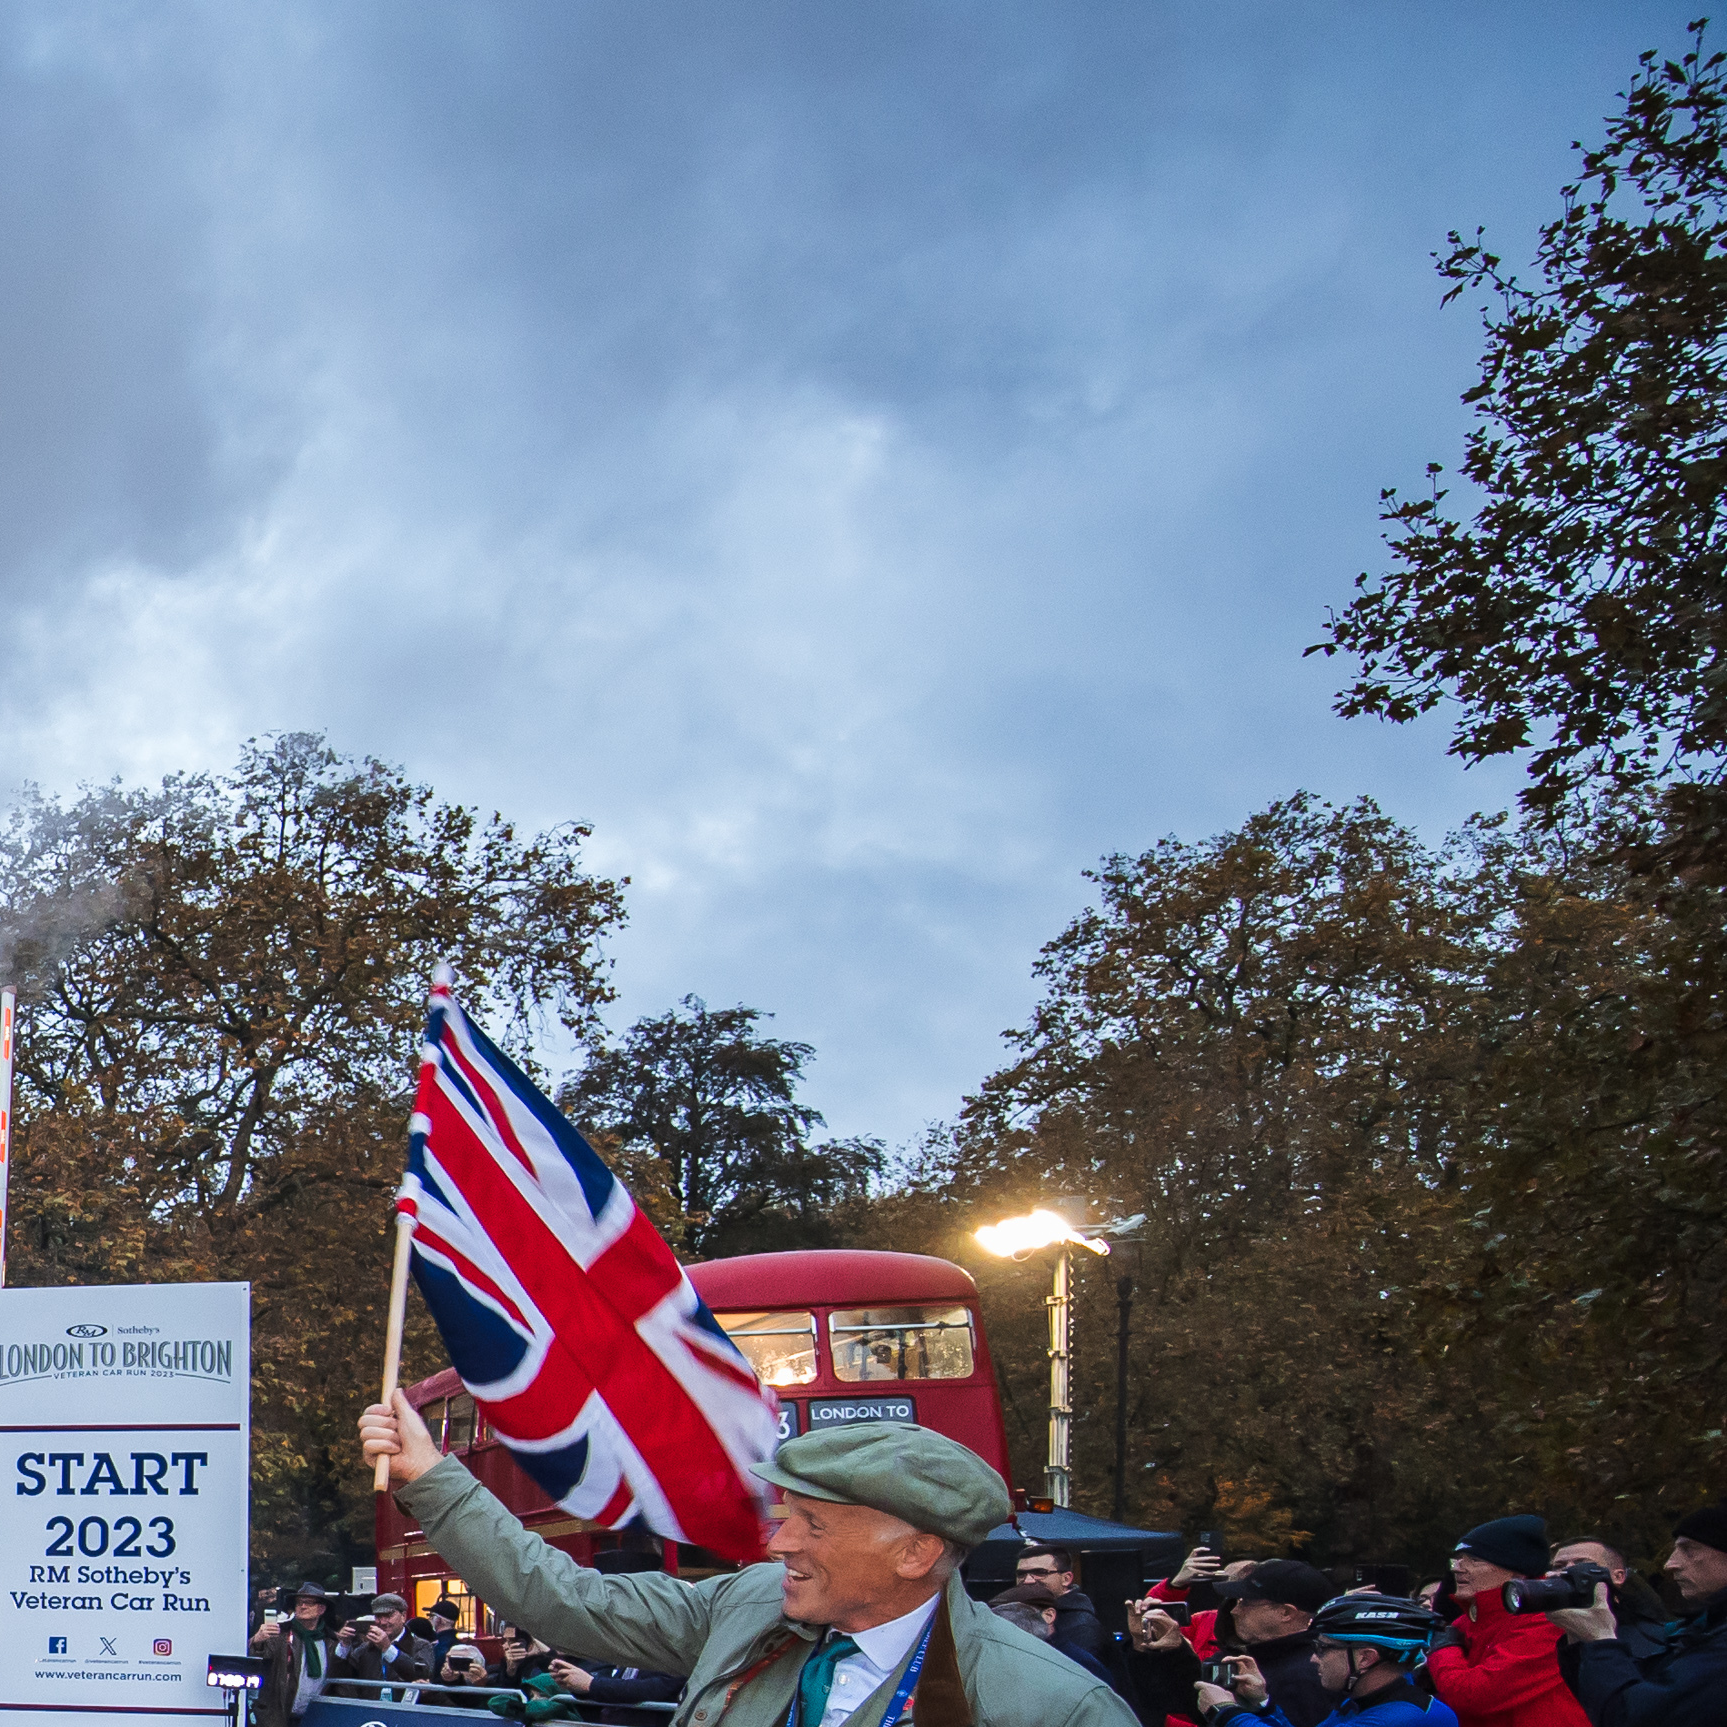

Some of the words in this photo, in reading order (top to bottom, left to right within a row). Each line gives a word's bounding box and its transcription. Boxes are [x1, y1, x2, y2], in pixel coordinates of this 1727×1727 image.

[117, 1326, 160, 1336] Sotheby's
[89, 1342, 117, 1368] TO
[122, 1340, 232, 1377] BRIGHTON
[53, 1370, 99, 1380] VETERAN
[126, 1369, 147, 1377] RUN
[811, 1406, 882, 1421] LONDON
[886, 1405, 909, 1417] TO
[16, 1452, 208, 1496] START
[45, 1516, 177, 1558] 2023
[29, 1565, 71, 1583] RM
[77, 1566, 191, 1589] Sotheby's
[9, 1591, 103, 1610] Veteran
[111, 1592, 155, 1611] Car
[162, 1593, 211, 1611] Run
[34, 1671, 182, 1682] www.veterancarrun.com
